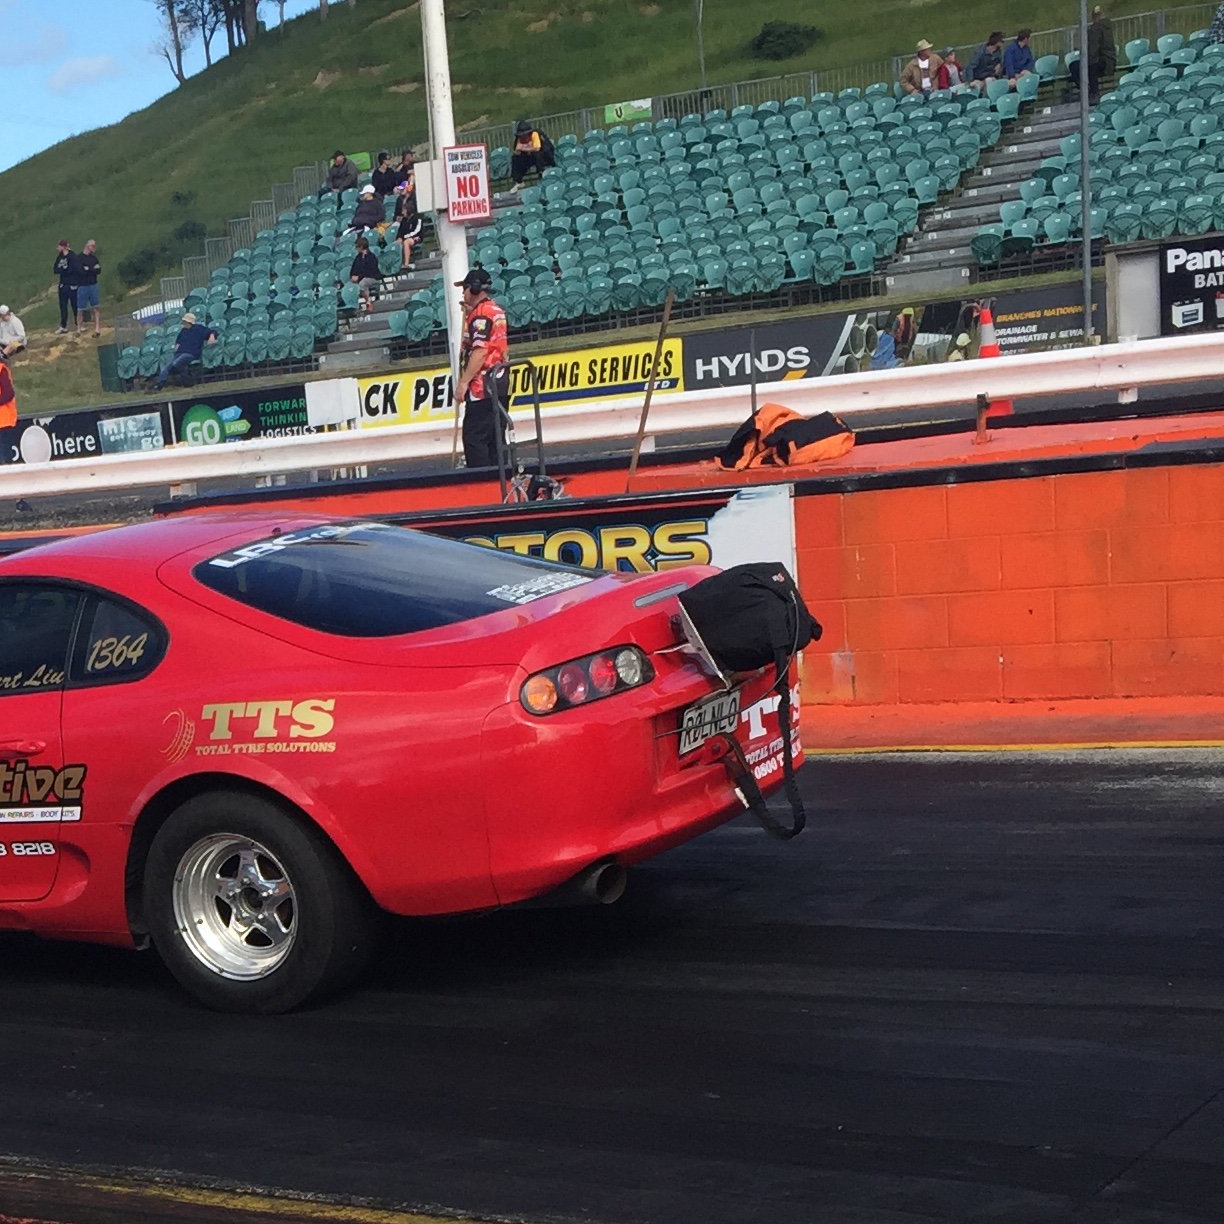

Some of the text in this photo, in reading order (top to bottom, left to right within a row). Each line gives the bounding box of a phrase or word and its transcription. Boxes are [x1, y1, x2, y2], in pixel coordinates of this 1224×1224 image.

[457, 175, 480, 198] NO
[452, 199, 487, 216] PARKING
[1167, 248, 1224, 273] Pan
[996, 303, 1097, 322] BRANCHES NATIONWE
[996, 332, 1048, 345] TORMWATER
[1058, 327, 1095, 339] SEWAE
[695, 346, 811, 380] HYNDS
[357, 382, 400, 417] CK
[511, 361, 580, 393] TOWING
[258, 398, 307, 413] FORWAR
[259, 412, 307, 426] THINKIN
[186, 419, 221, 446] GO
[260, 425, 317, 438] LOGISTICS
[51, 432, 96, 456] here
[86, 633, 148, 672] 1364
[24, 664, 65, 686] Liu
[202, 699, 336, 740] TTS
[195, 742, 336, 756] TOTAL TYRE SOLUTIONS
[13, 842, 56, 856] 8218
